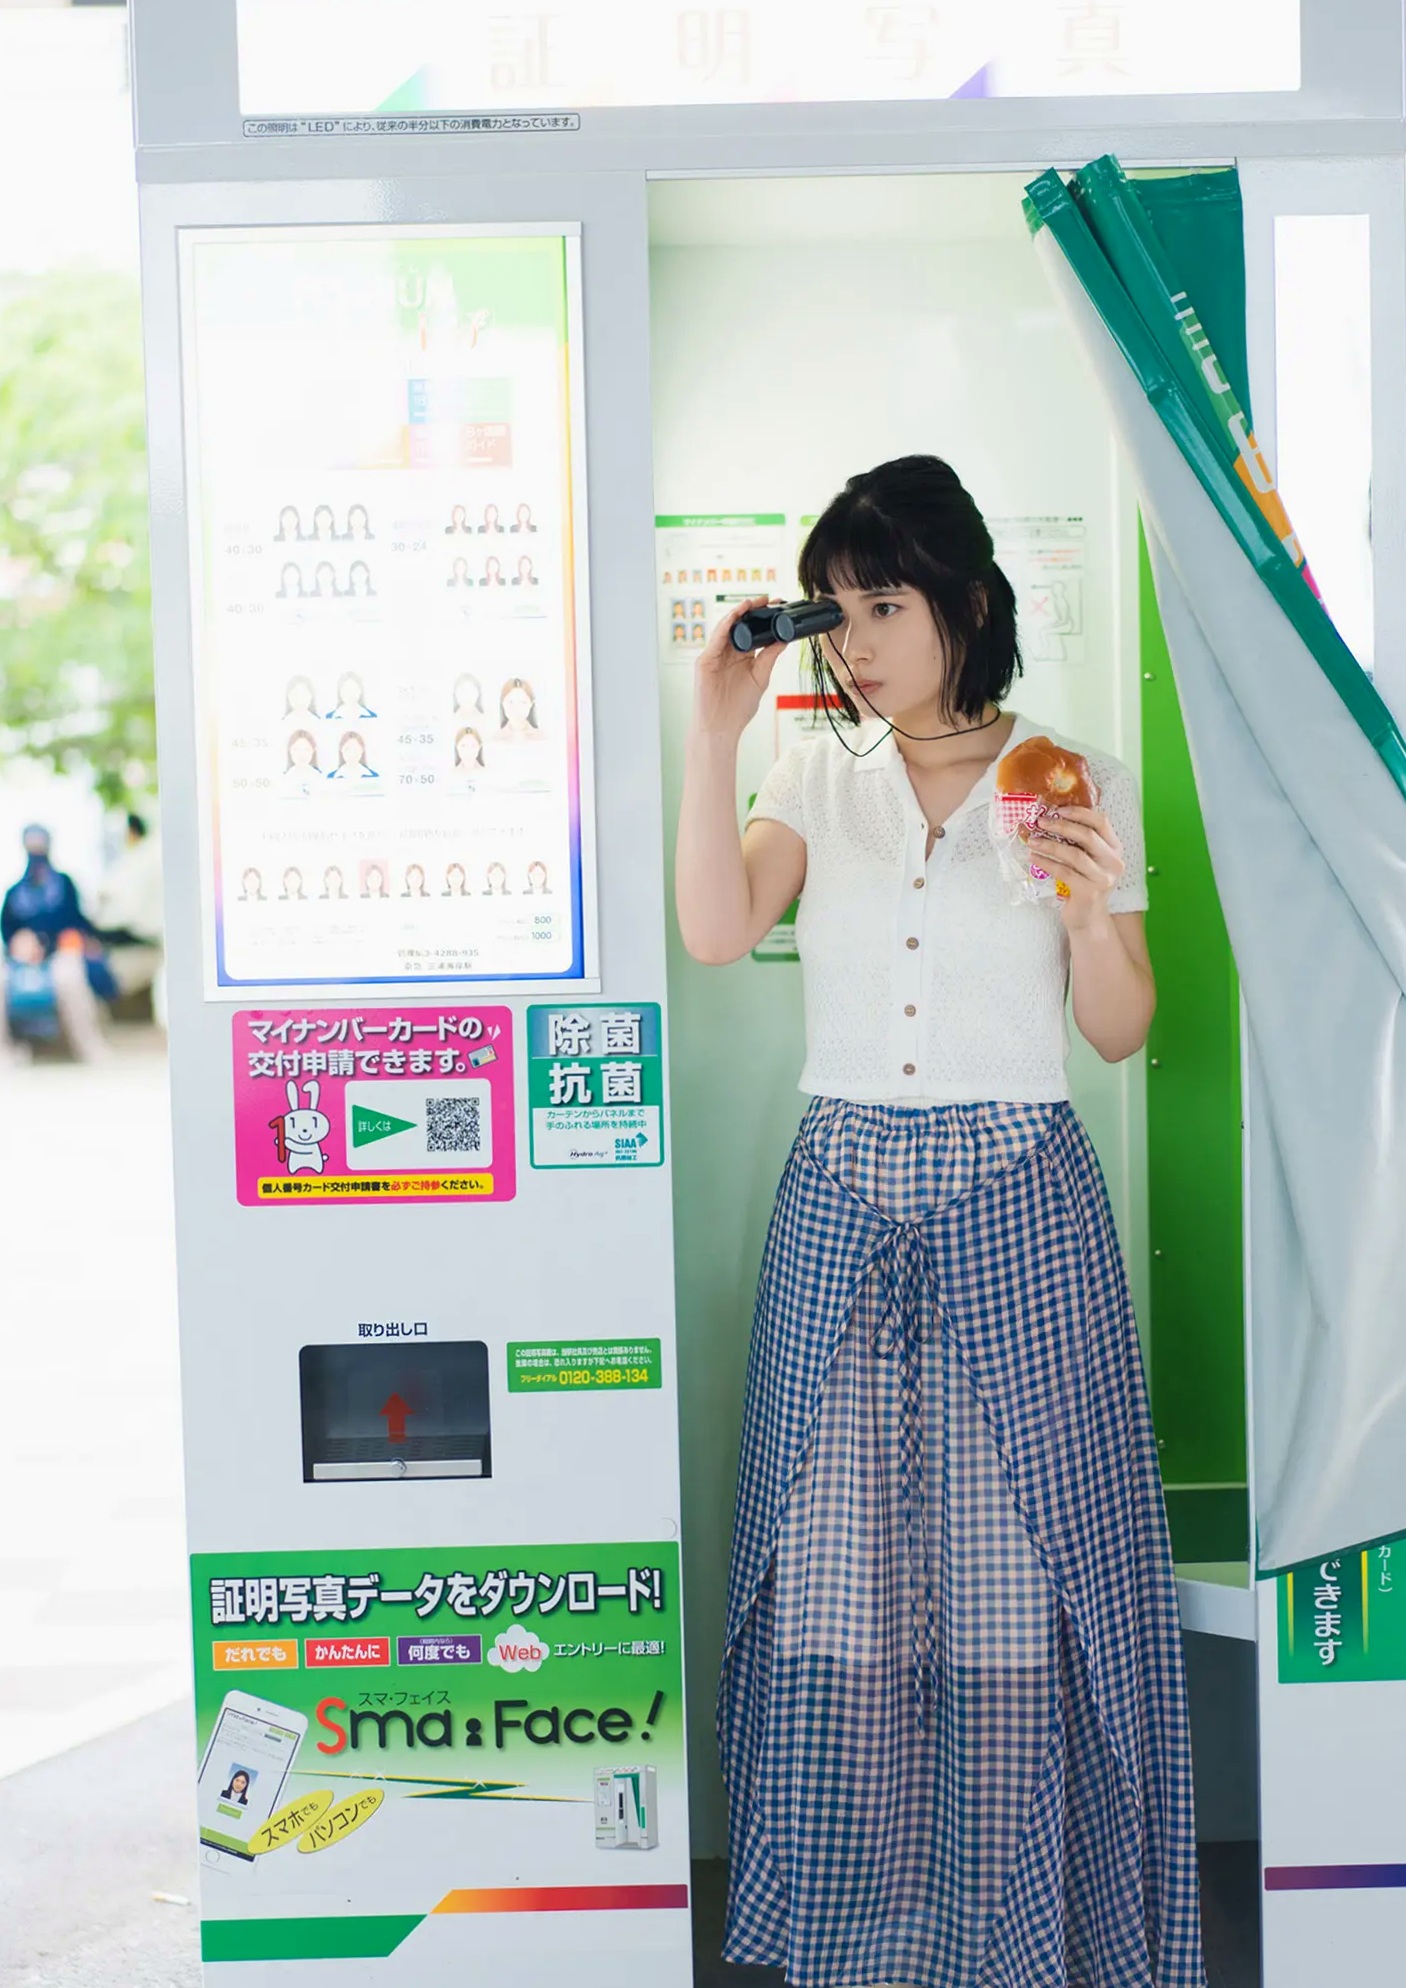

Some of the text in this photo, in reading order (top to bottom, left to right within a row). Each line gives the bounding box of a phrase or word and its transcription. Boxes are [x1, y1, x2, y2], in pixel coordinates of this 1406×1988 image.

[531, 930, 552, 940] 1000
[248, 1015, 483, 1044] マイナンバーカードの
[548, 1012, 642, 1056] 除菌
[248, 1048, 467, 1078] 交付申請できます。
[548, 1061, 643, 1105] 抗菌
[547, 1108, 646, 1119] カーテンからパネルまで
[357, 1120, 392, 1133] 詳しくは
[615, 1138, 637, 1149] SIAA
[261, 1178, 485, 1194] 個人番号カード交付申請書を必ずご持参ください。
[358, 1322, 428, 1338] 取り出し口
[559, 1369, 649, 1385] 0120-388-134
[224, 1646, 287, 1663] だれでも
[314, 1643, 381, 1661] かんたんに
[408, 1644, 471, 1661] 何度でも
[499, 1644, 542, 1661] Web
[261, 1802, 319, 1847] スマホでも
[309, 1795, 377, 1848] パソコンでも
